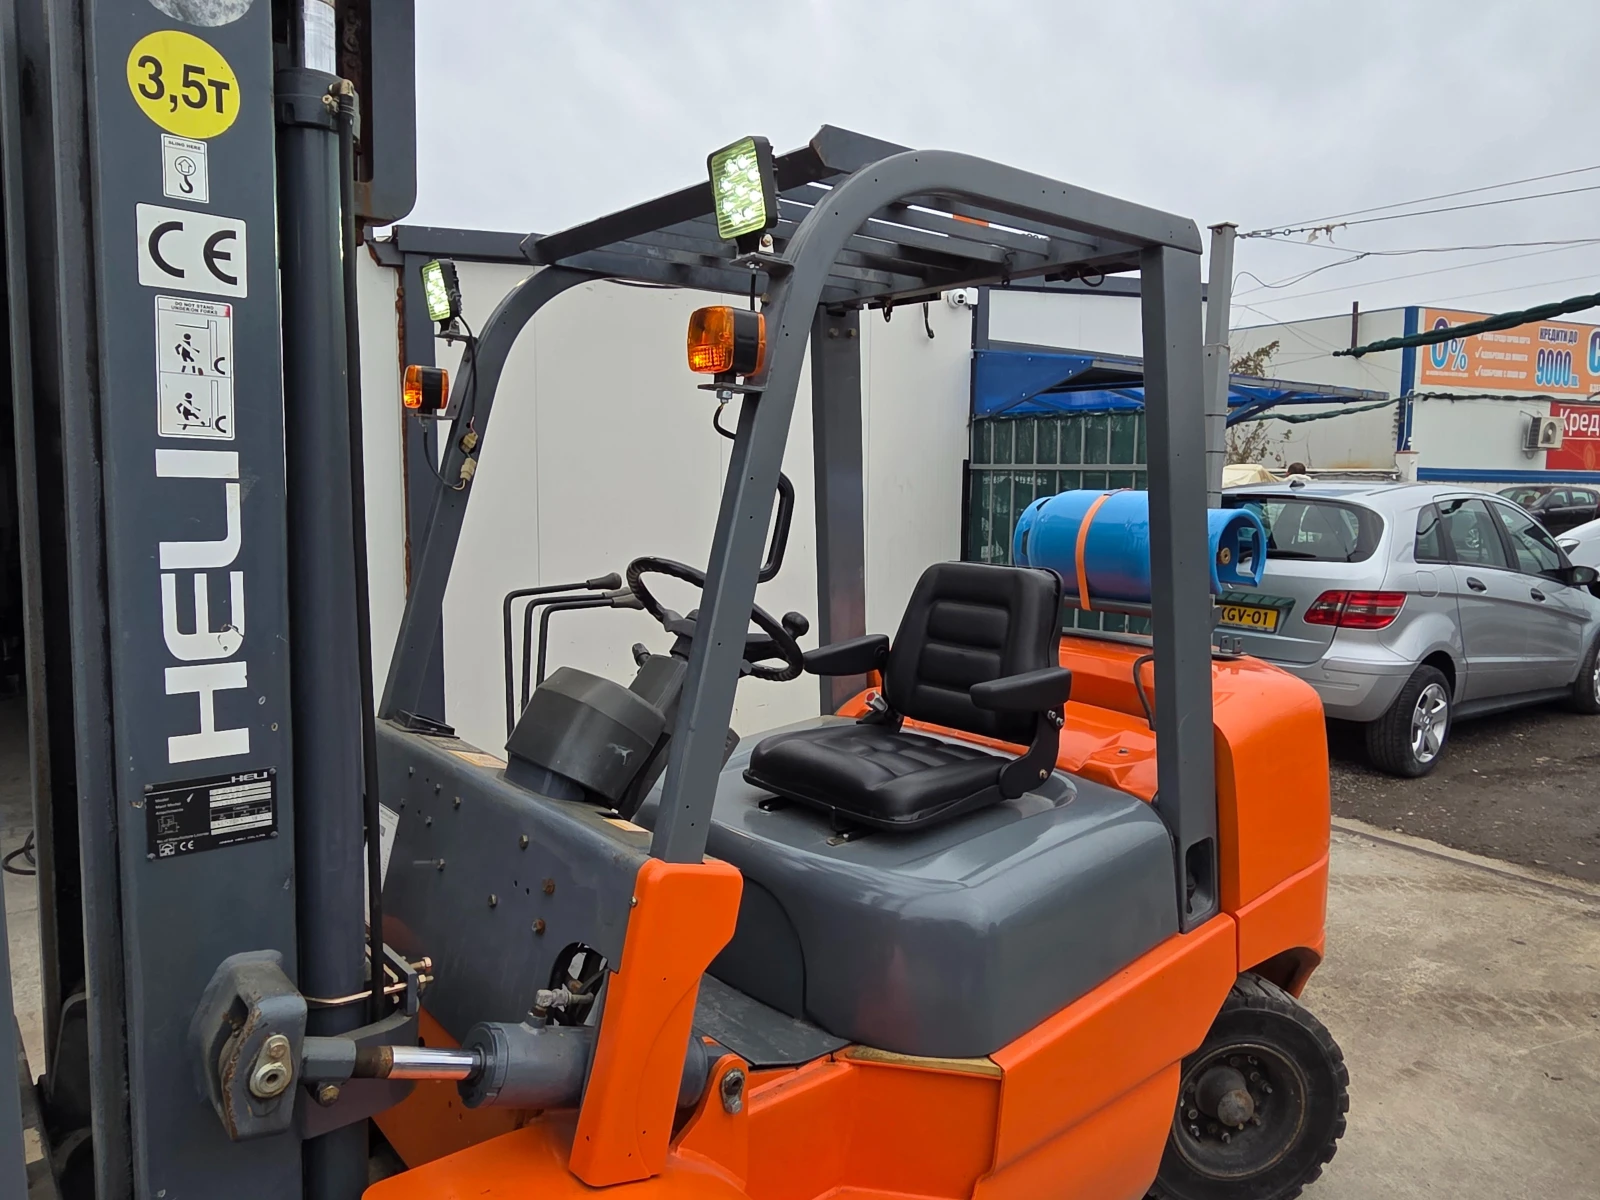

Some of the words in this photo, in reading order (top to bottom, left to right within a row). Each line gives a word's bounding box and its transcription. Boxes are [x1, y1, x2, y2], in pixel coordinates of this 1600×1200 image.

[168, 140, 185, 148] SLING
[186, 143, 201, 151] HERE
[148, 221, 238, 286] CE
[1430, 317, 1468, 371] 0%
[1536, 347, 1572, 387] 9000
[155, 449, 250, 763] HELI
